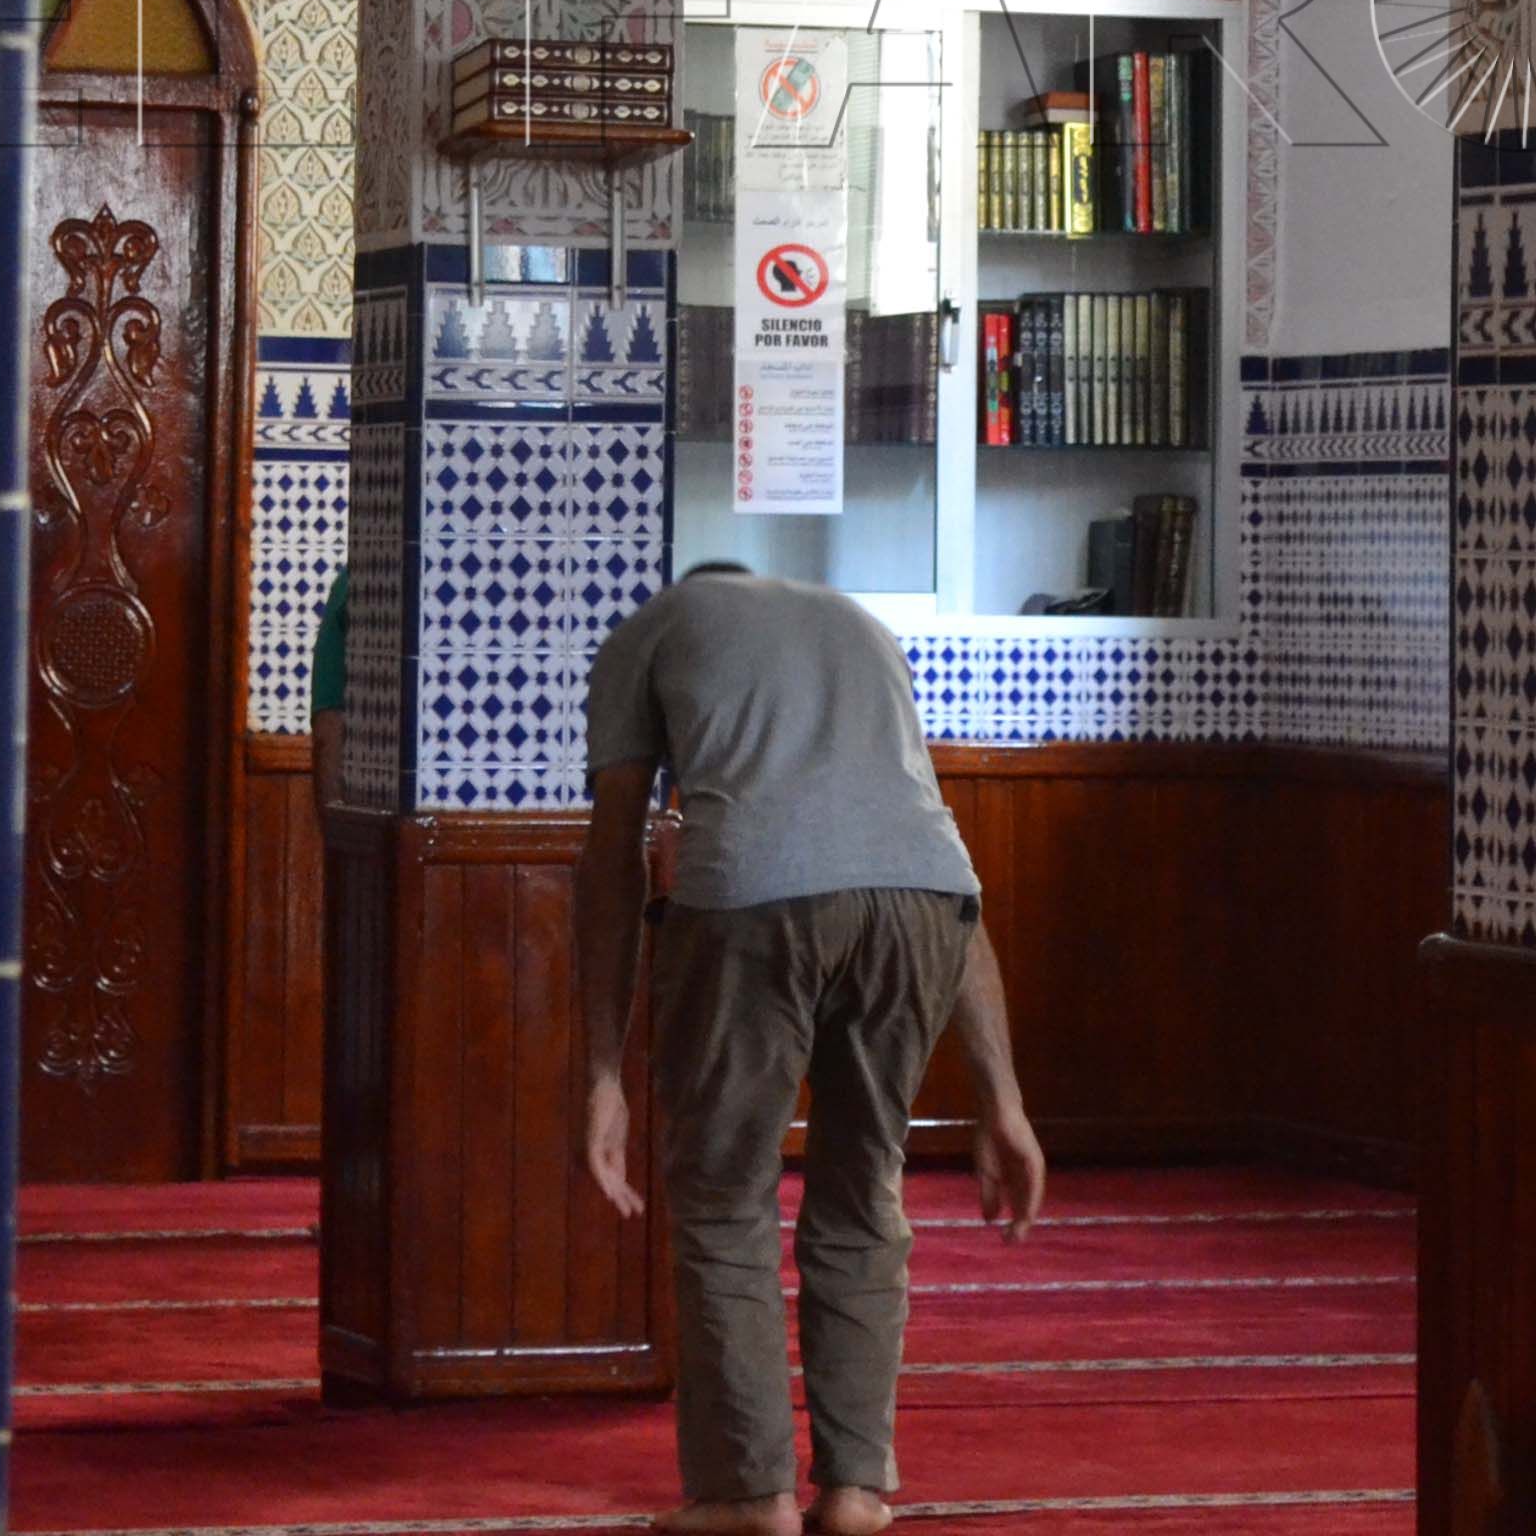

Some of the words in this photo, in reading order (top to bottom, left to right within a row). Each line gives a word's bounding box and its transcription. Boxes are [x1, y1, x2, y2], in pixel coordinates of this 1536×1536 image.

[761, 318, 823, 332] SILENCIO
[755, 334, 782, 347] POR
[786, 334, 829, 348] FAVOR
